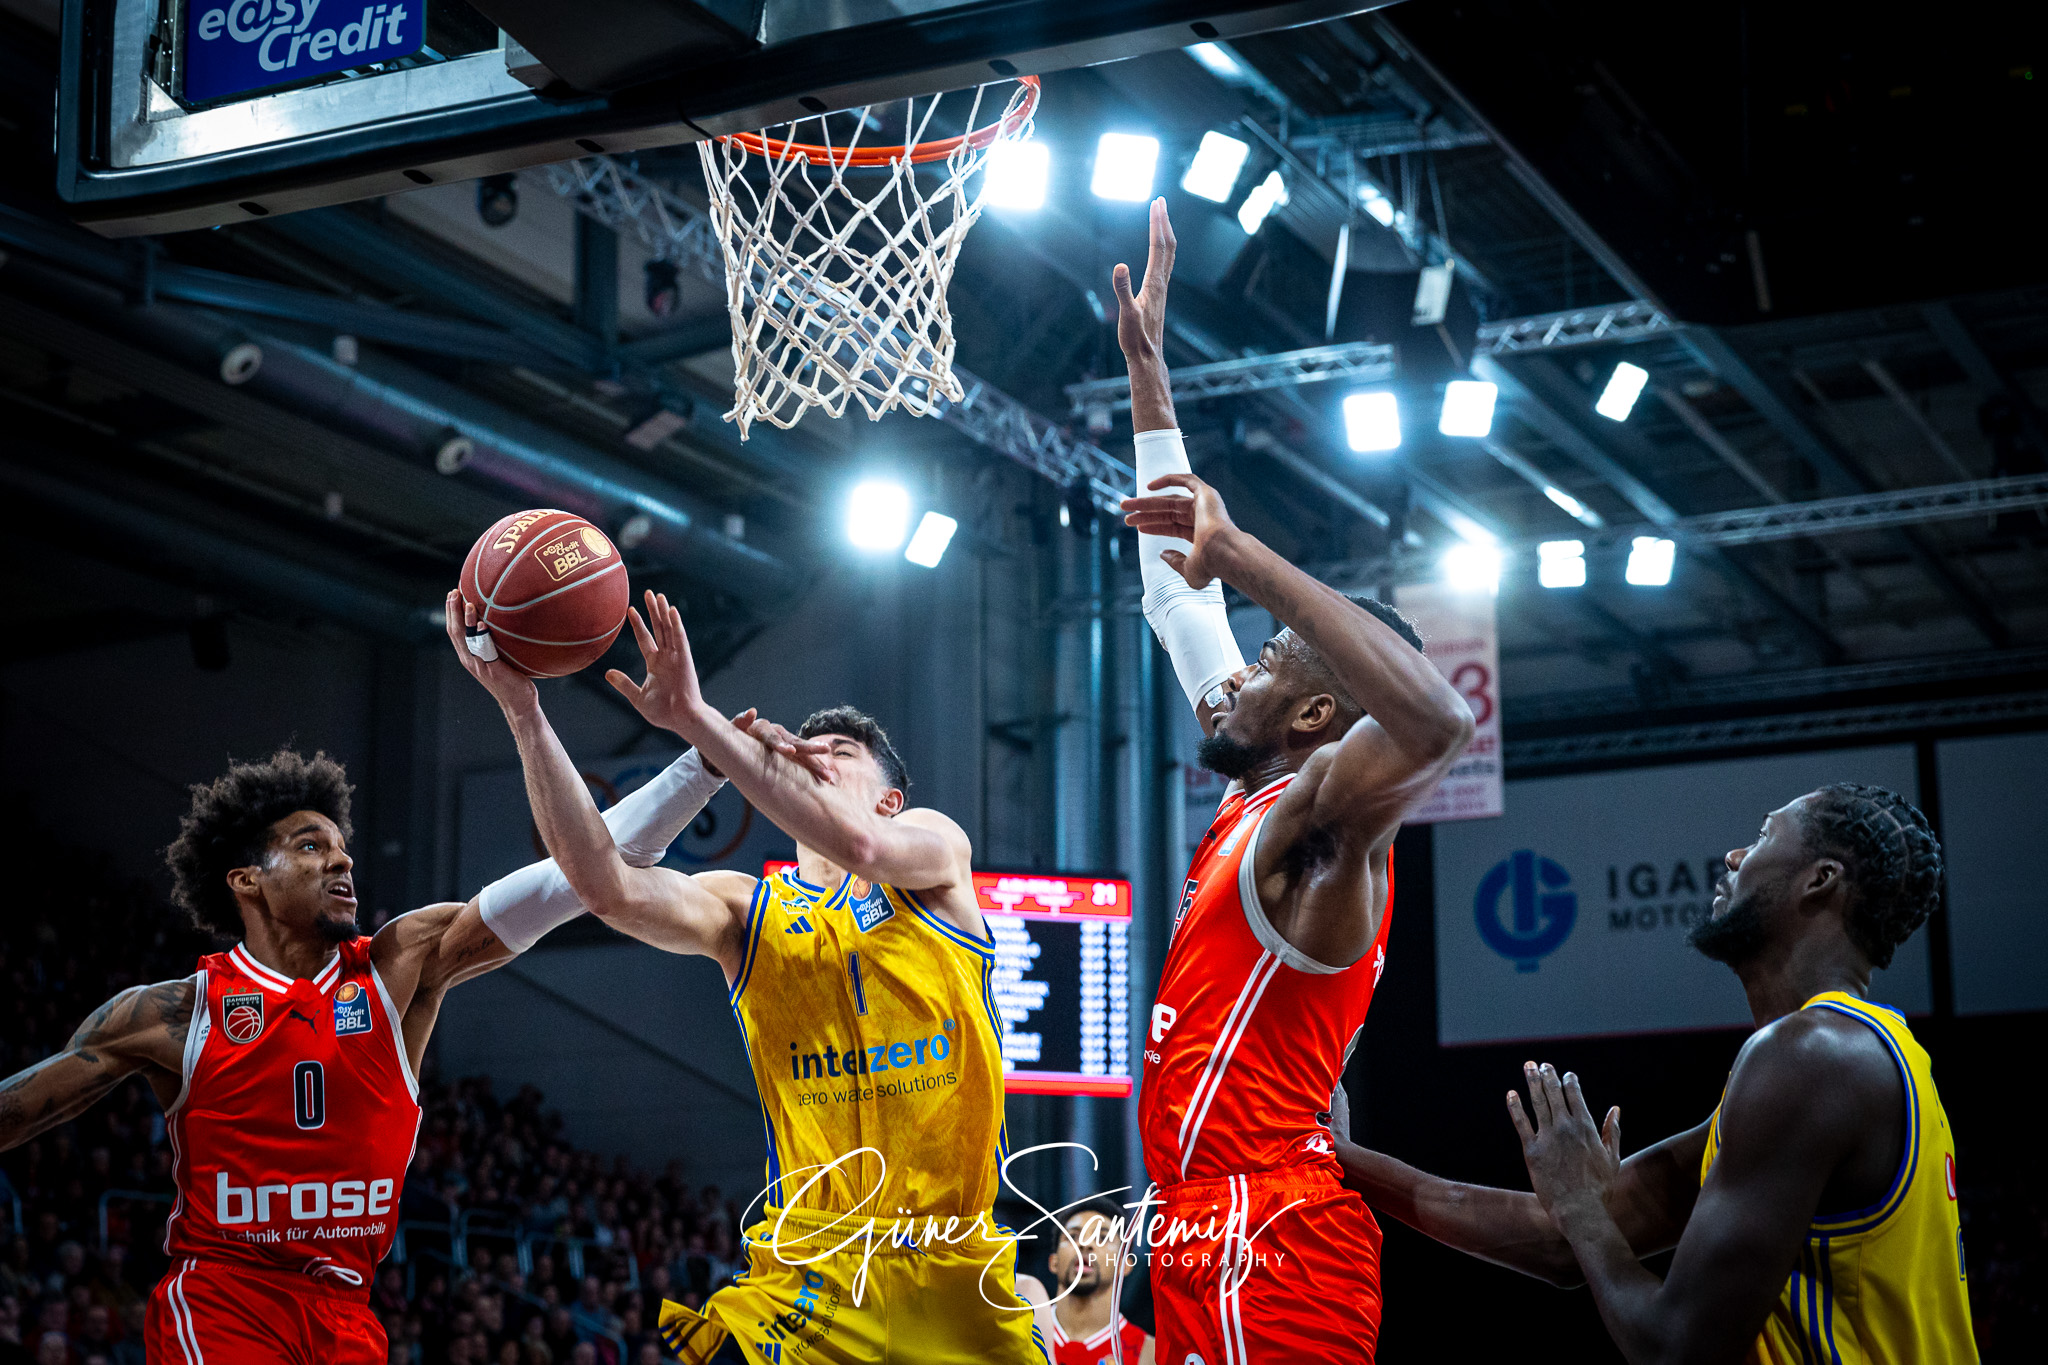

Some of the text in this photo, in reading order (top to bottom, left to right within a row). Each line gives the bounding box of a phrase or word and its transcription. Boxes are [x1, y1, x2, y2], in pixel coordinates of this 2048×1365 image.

[258, 3, 408, 72] Credit
[556, 541, 580, 556] Credit
[553, 549, 588, 575] BBL
[861, 905, 889, 928] BBL
[848, 951, 868, 1017] 1
[336, 1016, 366, 1031] BBL
[342, 1009, 365, 1018] Credit
[294, 1060, 325, 1130] 0
[877, 1071, 957, 1098] solutions
[216, 1172, 394, 1224] brose
[286, 1227, 309, 1241] für
[313, 1221, 387, 1240] Automobile
